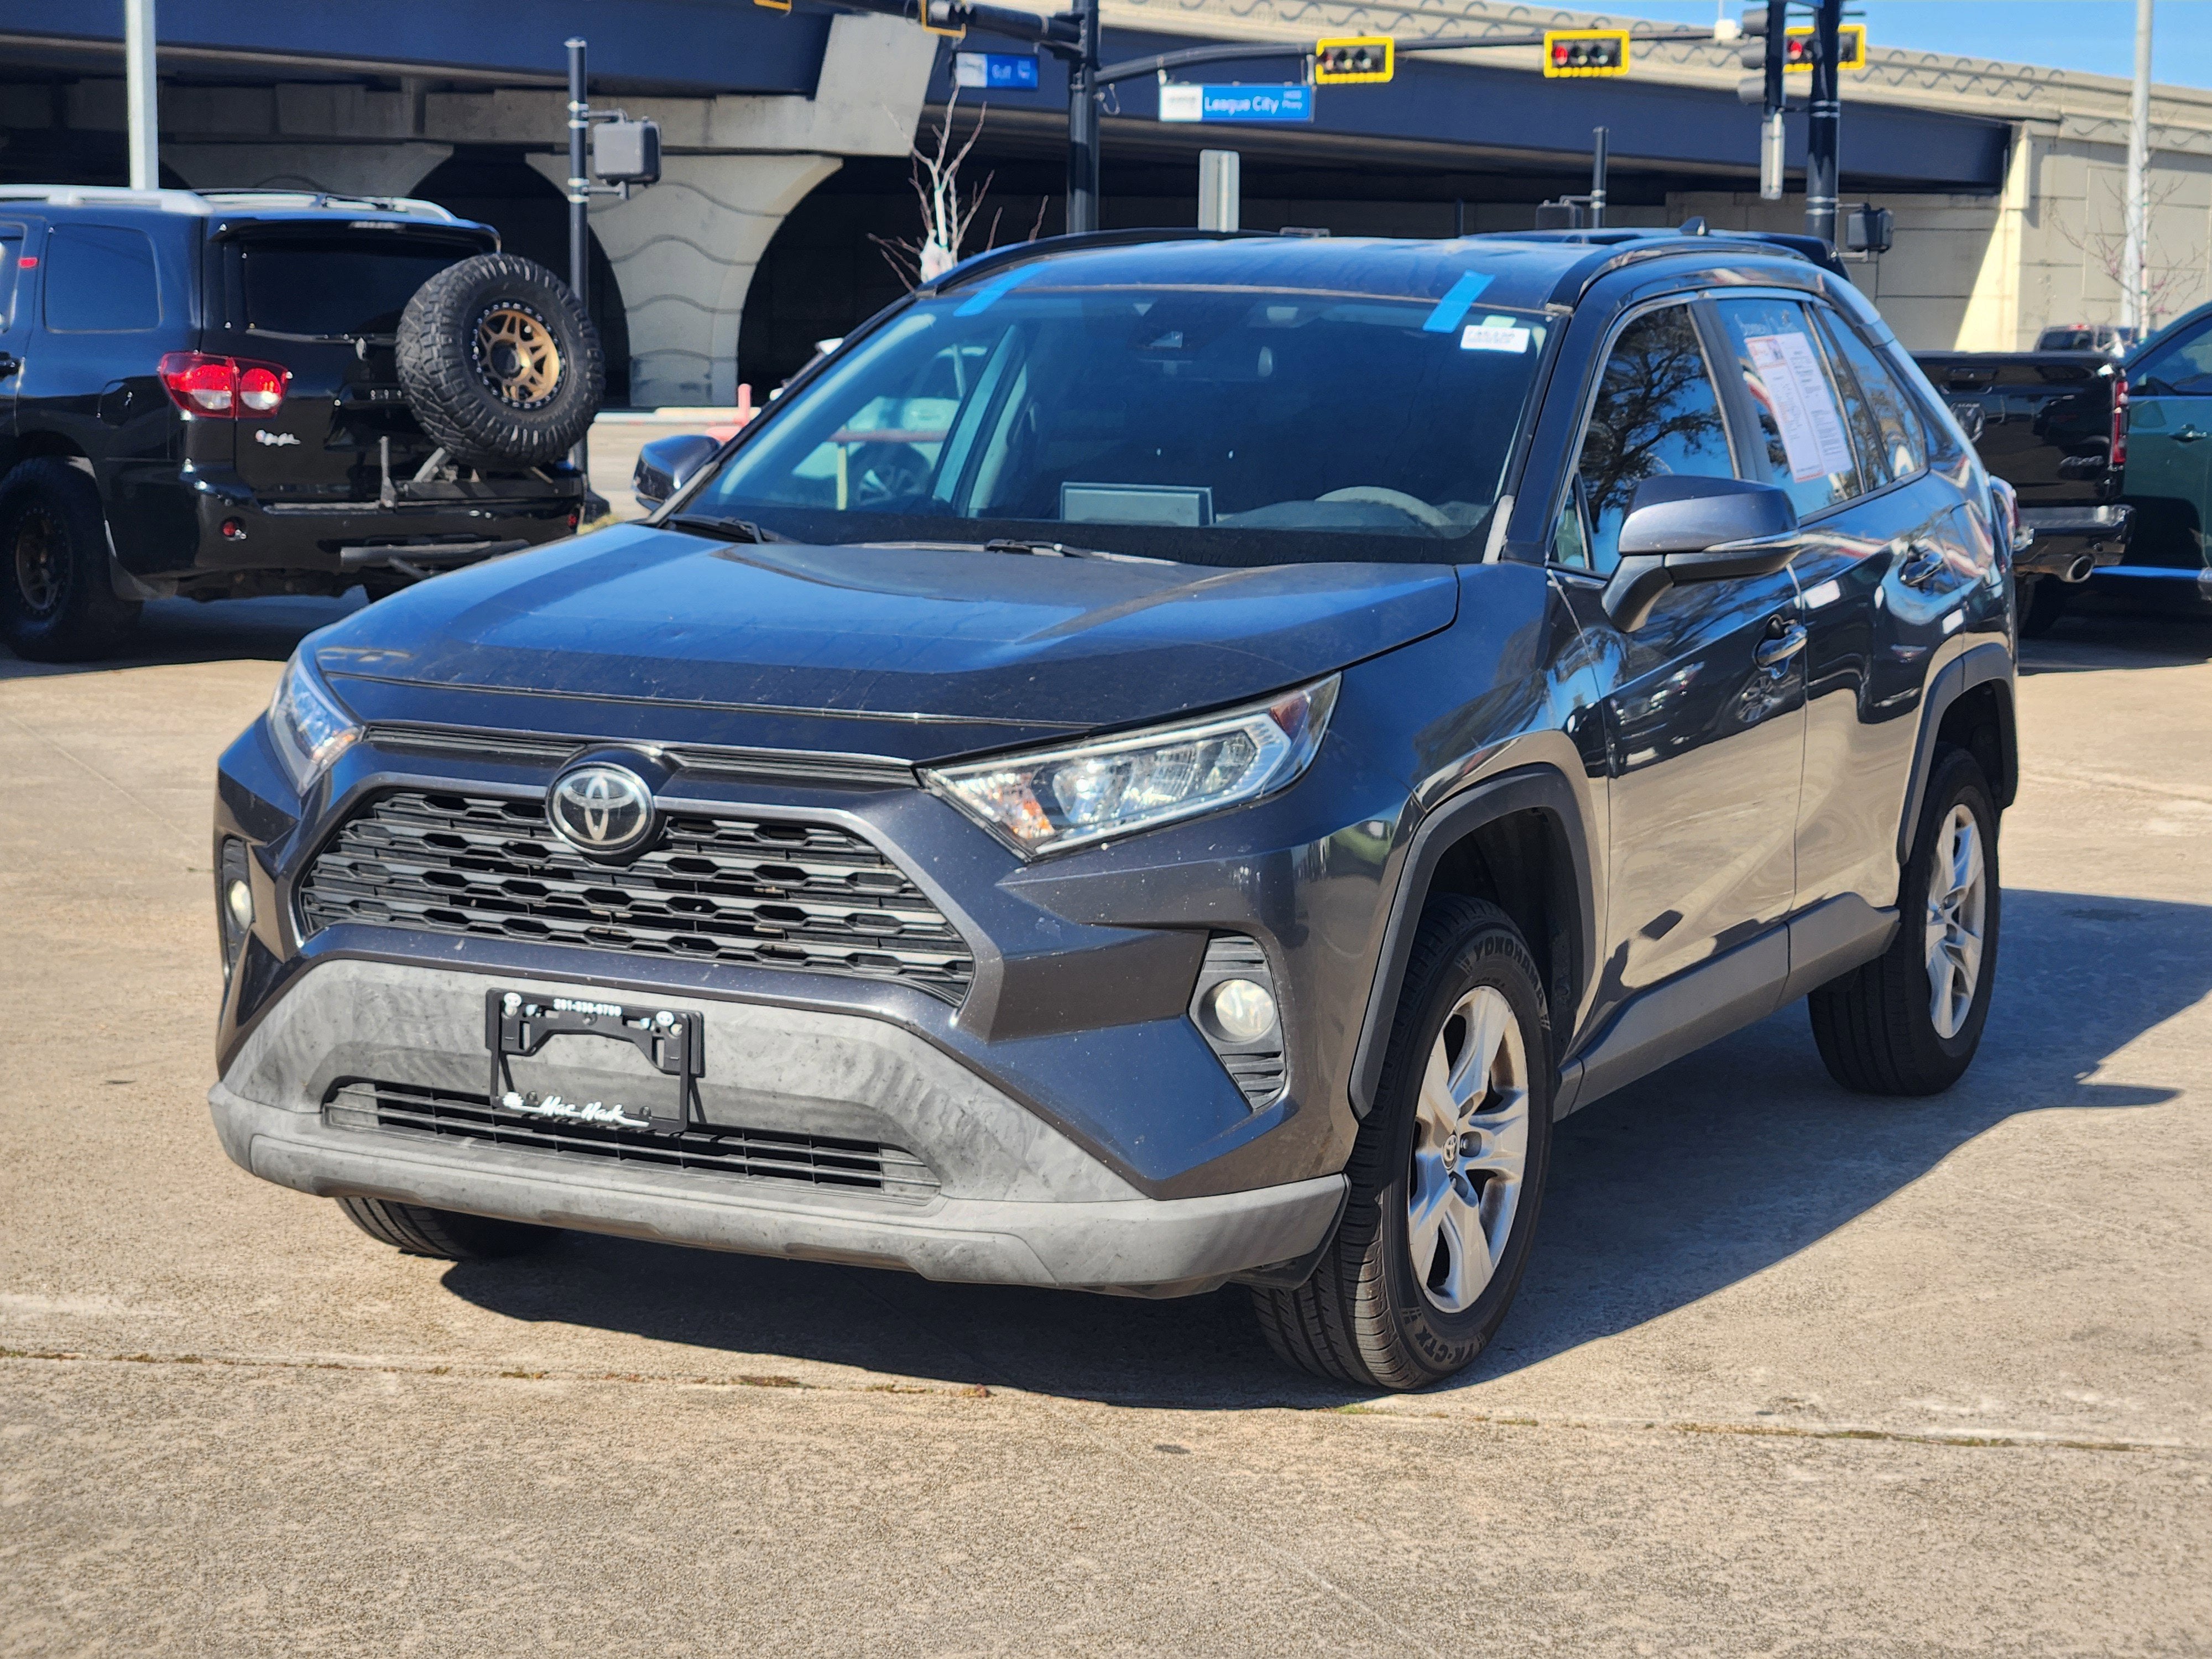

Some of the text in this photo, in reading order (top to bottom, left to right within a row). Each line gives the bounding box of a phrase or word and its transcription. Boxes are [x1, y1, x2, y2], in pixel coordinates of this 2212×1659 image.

[1204, 96, 1251, 116] League
[1253, 96, 1280, 114] City
[1473, 936, 1545, 1009] YOKOHAMA
